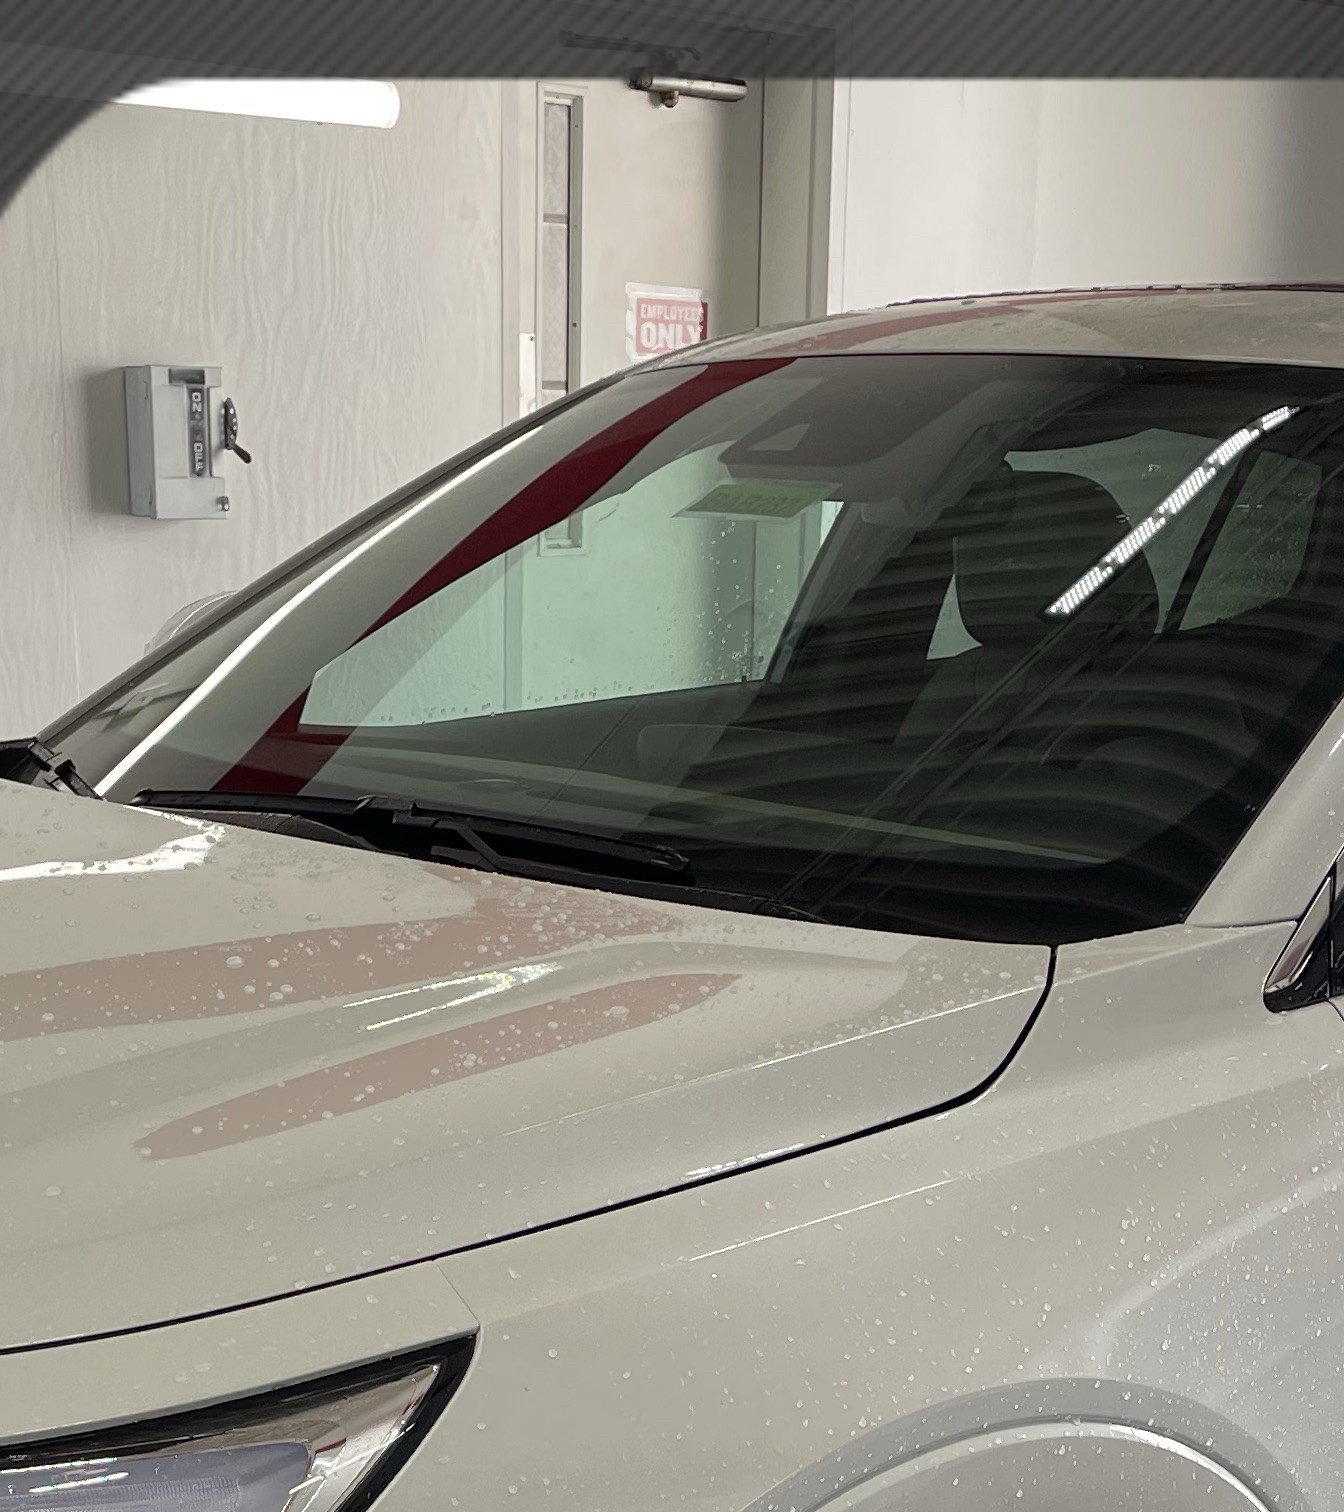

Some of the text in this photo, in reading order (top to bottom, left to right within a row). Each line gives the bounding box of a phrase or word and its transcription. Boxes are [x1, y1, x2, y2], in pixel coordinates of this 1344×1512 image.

[640, 303, 704, 322] EMPLOYEES
[640, 322, 703, 350] ONLY
[191, 392, 203, 412] ON
[193, 442, 205, 472] OFF
